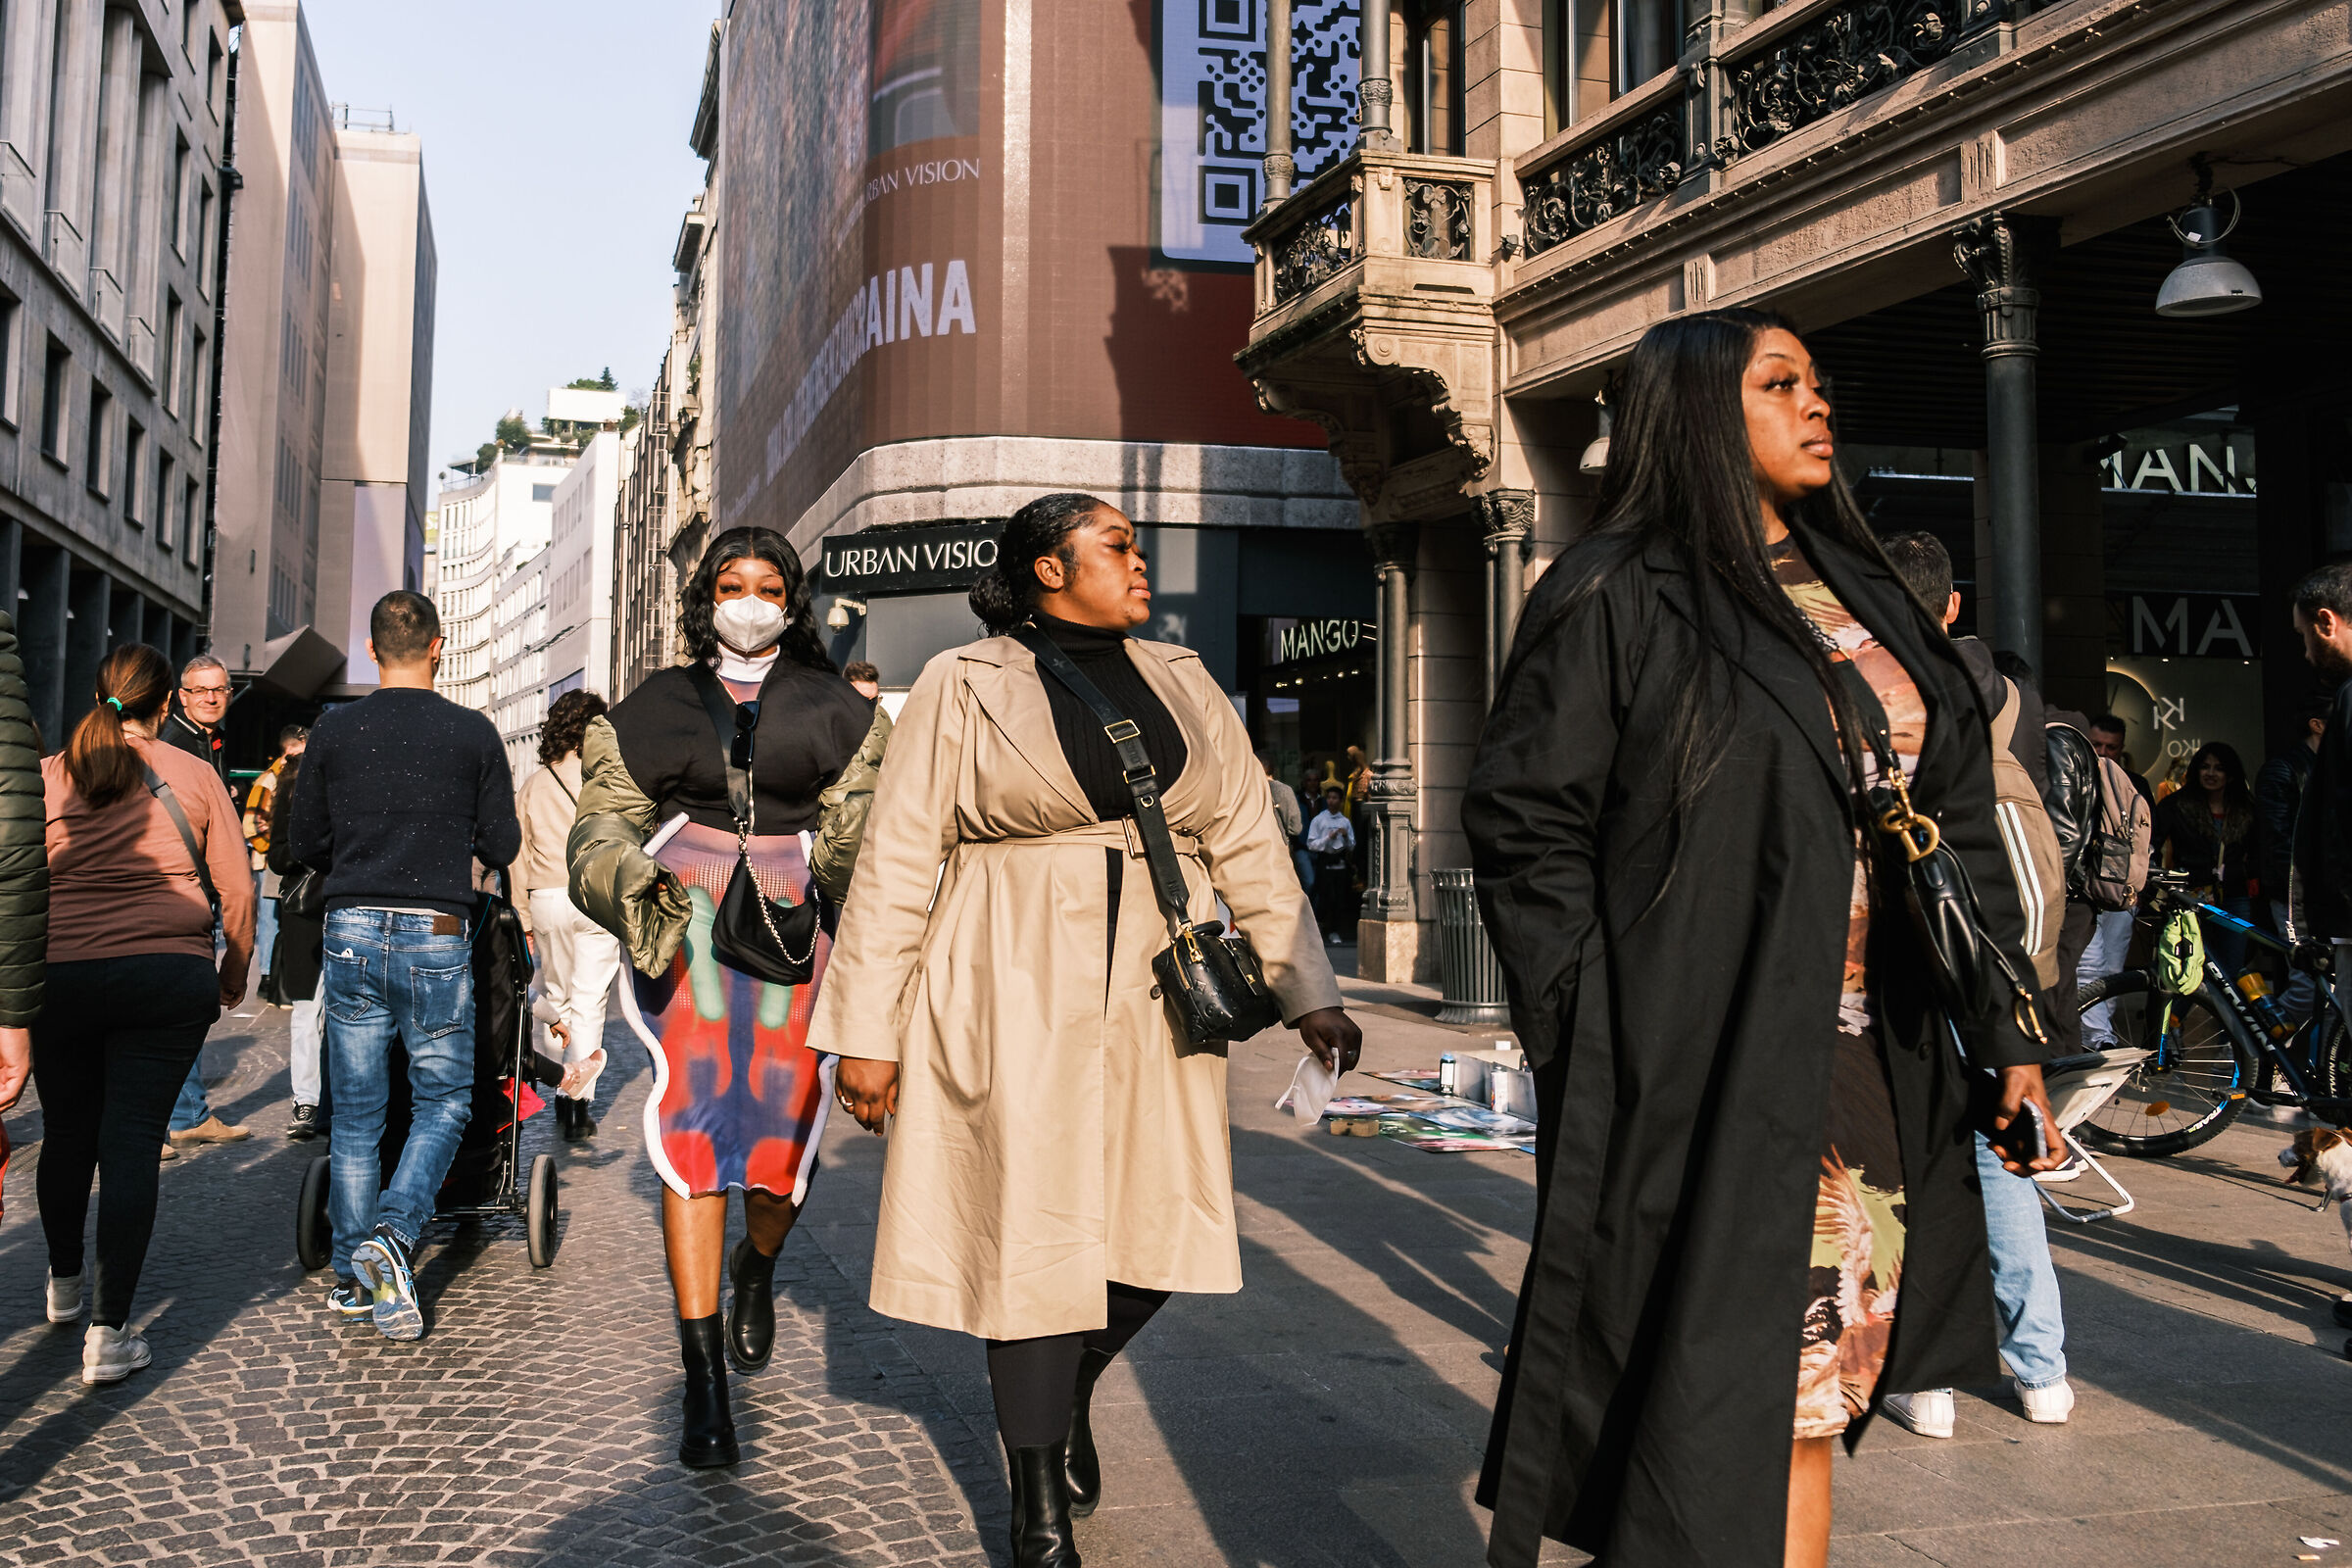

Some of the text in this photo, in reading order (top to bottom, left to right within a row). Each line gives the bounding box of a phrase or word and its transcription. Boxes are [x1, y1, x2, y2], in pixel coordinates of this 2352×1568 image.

[905, 158, 980, 187] VISION
[825, 539, 999, 577] URBAN VISIO
[1280, 619, 1359, 662] MANGO
[2132, 595, 2255, 658] MA
